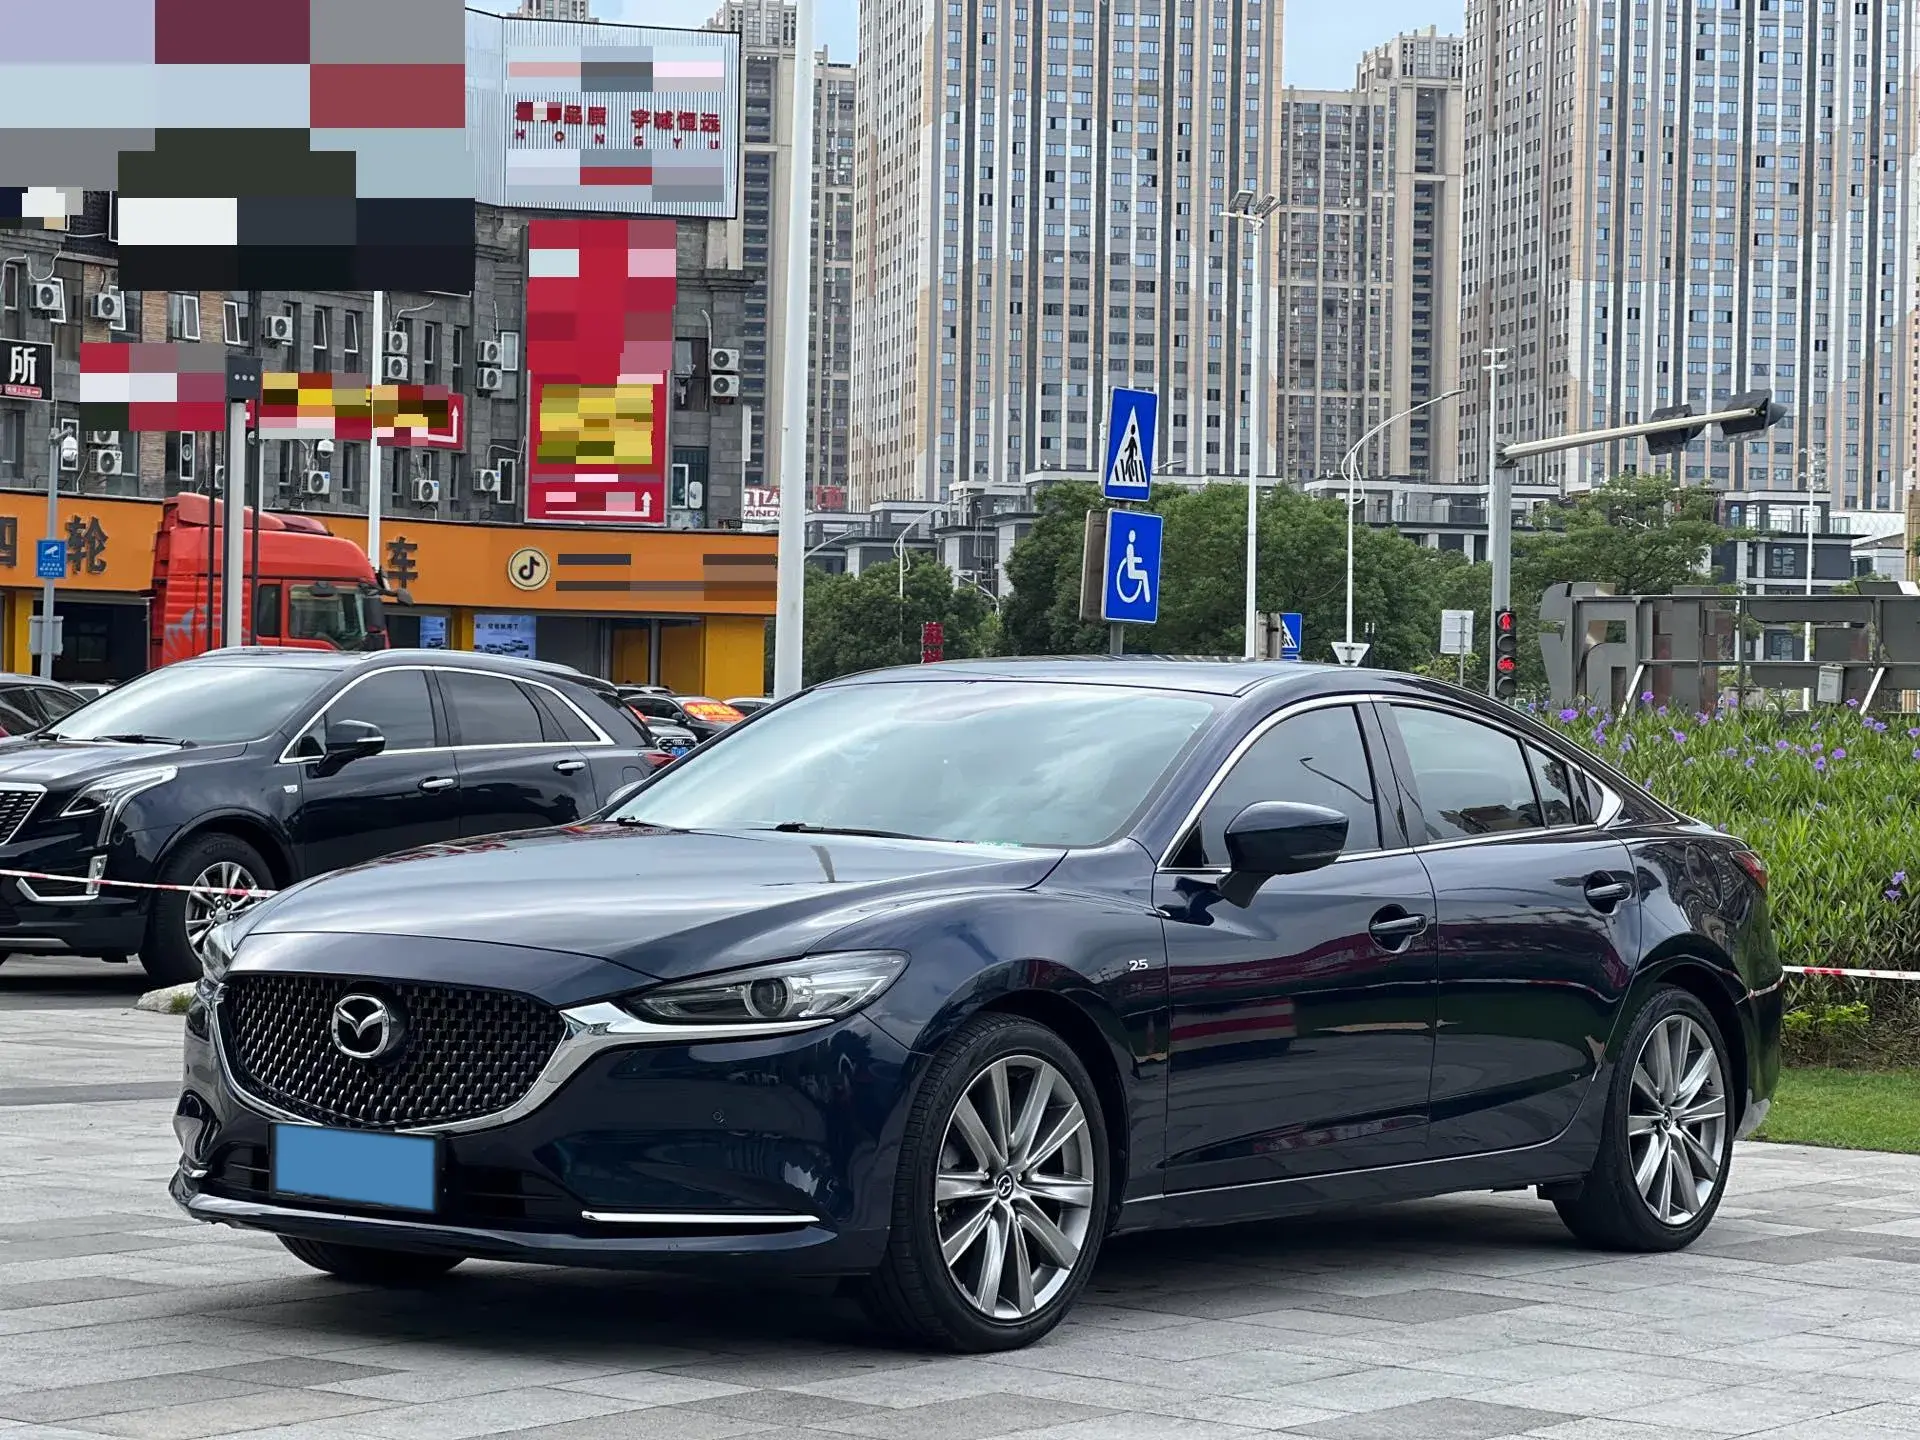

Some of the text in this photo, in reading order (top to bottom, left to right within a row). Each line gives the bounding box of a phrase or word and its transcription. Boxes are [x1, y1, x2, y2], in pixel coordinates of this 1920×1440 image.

[10, 346, 37, 385] 所
[743, 509, 780, 517] AND
[386, 536, 418, 589] 车
[1128, 959, 1149, 971] 25
